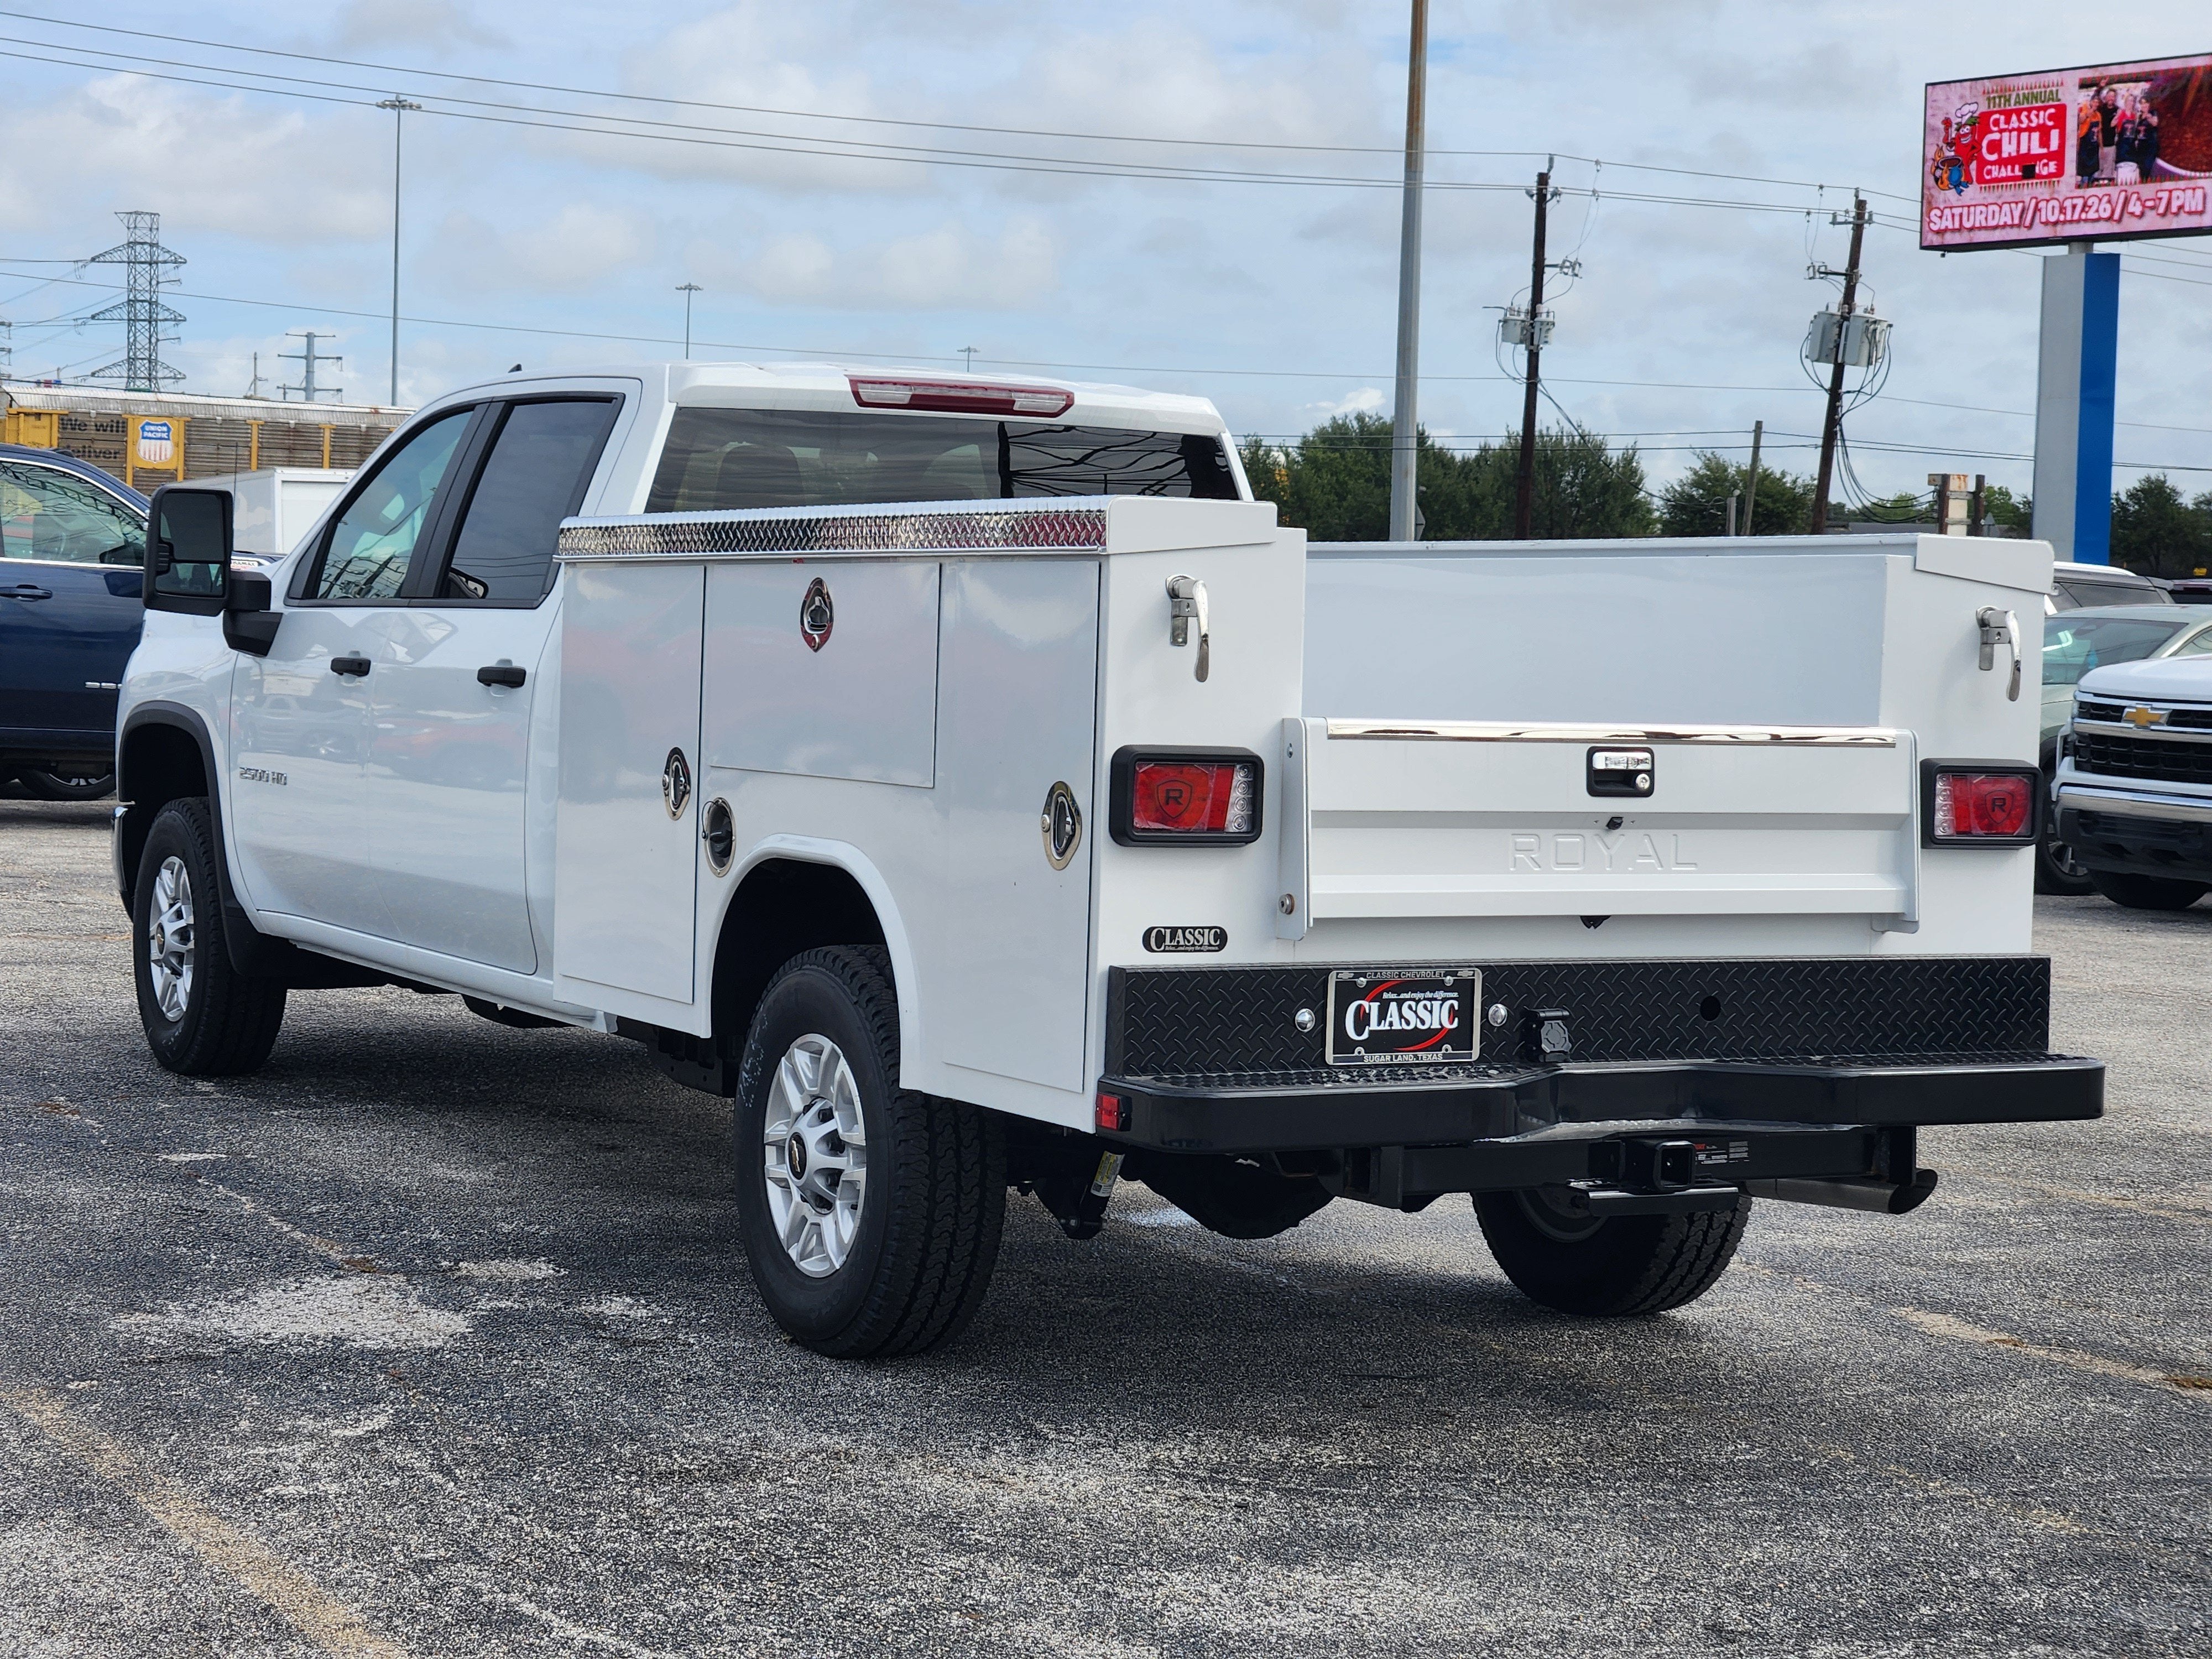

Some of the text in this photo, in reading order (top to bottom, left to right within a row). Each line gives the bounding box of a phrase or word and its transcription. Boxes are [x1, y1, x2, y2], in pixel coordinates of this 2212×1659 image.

[1986, 88, 2062, 109] 11TH ANNUAL
[1990, 108, 2056, 131] CLASSIC
[1981, 128, 2060, 161] CHILI
[1983, 159, 2058, 180] CHALLGE
[60, 418, 126, 433] We will
[239, 766, 287, 786] 2500 HD
[1165, 788, 1184, 806] R
[1992, 796, 2007, 812] R
[1509, 833, 1698, 871] ROYAL
[1150, 927, 1220, 951] CLASSIC
[1345, 999, 1459, 1041] CLASSIC
[1363, 1055, 1391, 1063] SUGAR
